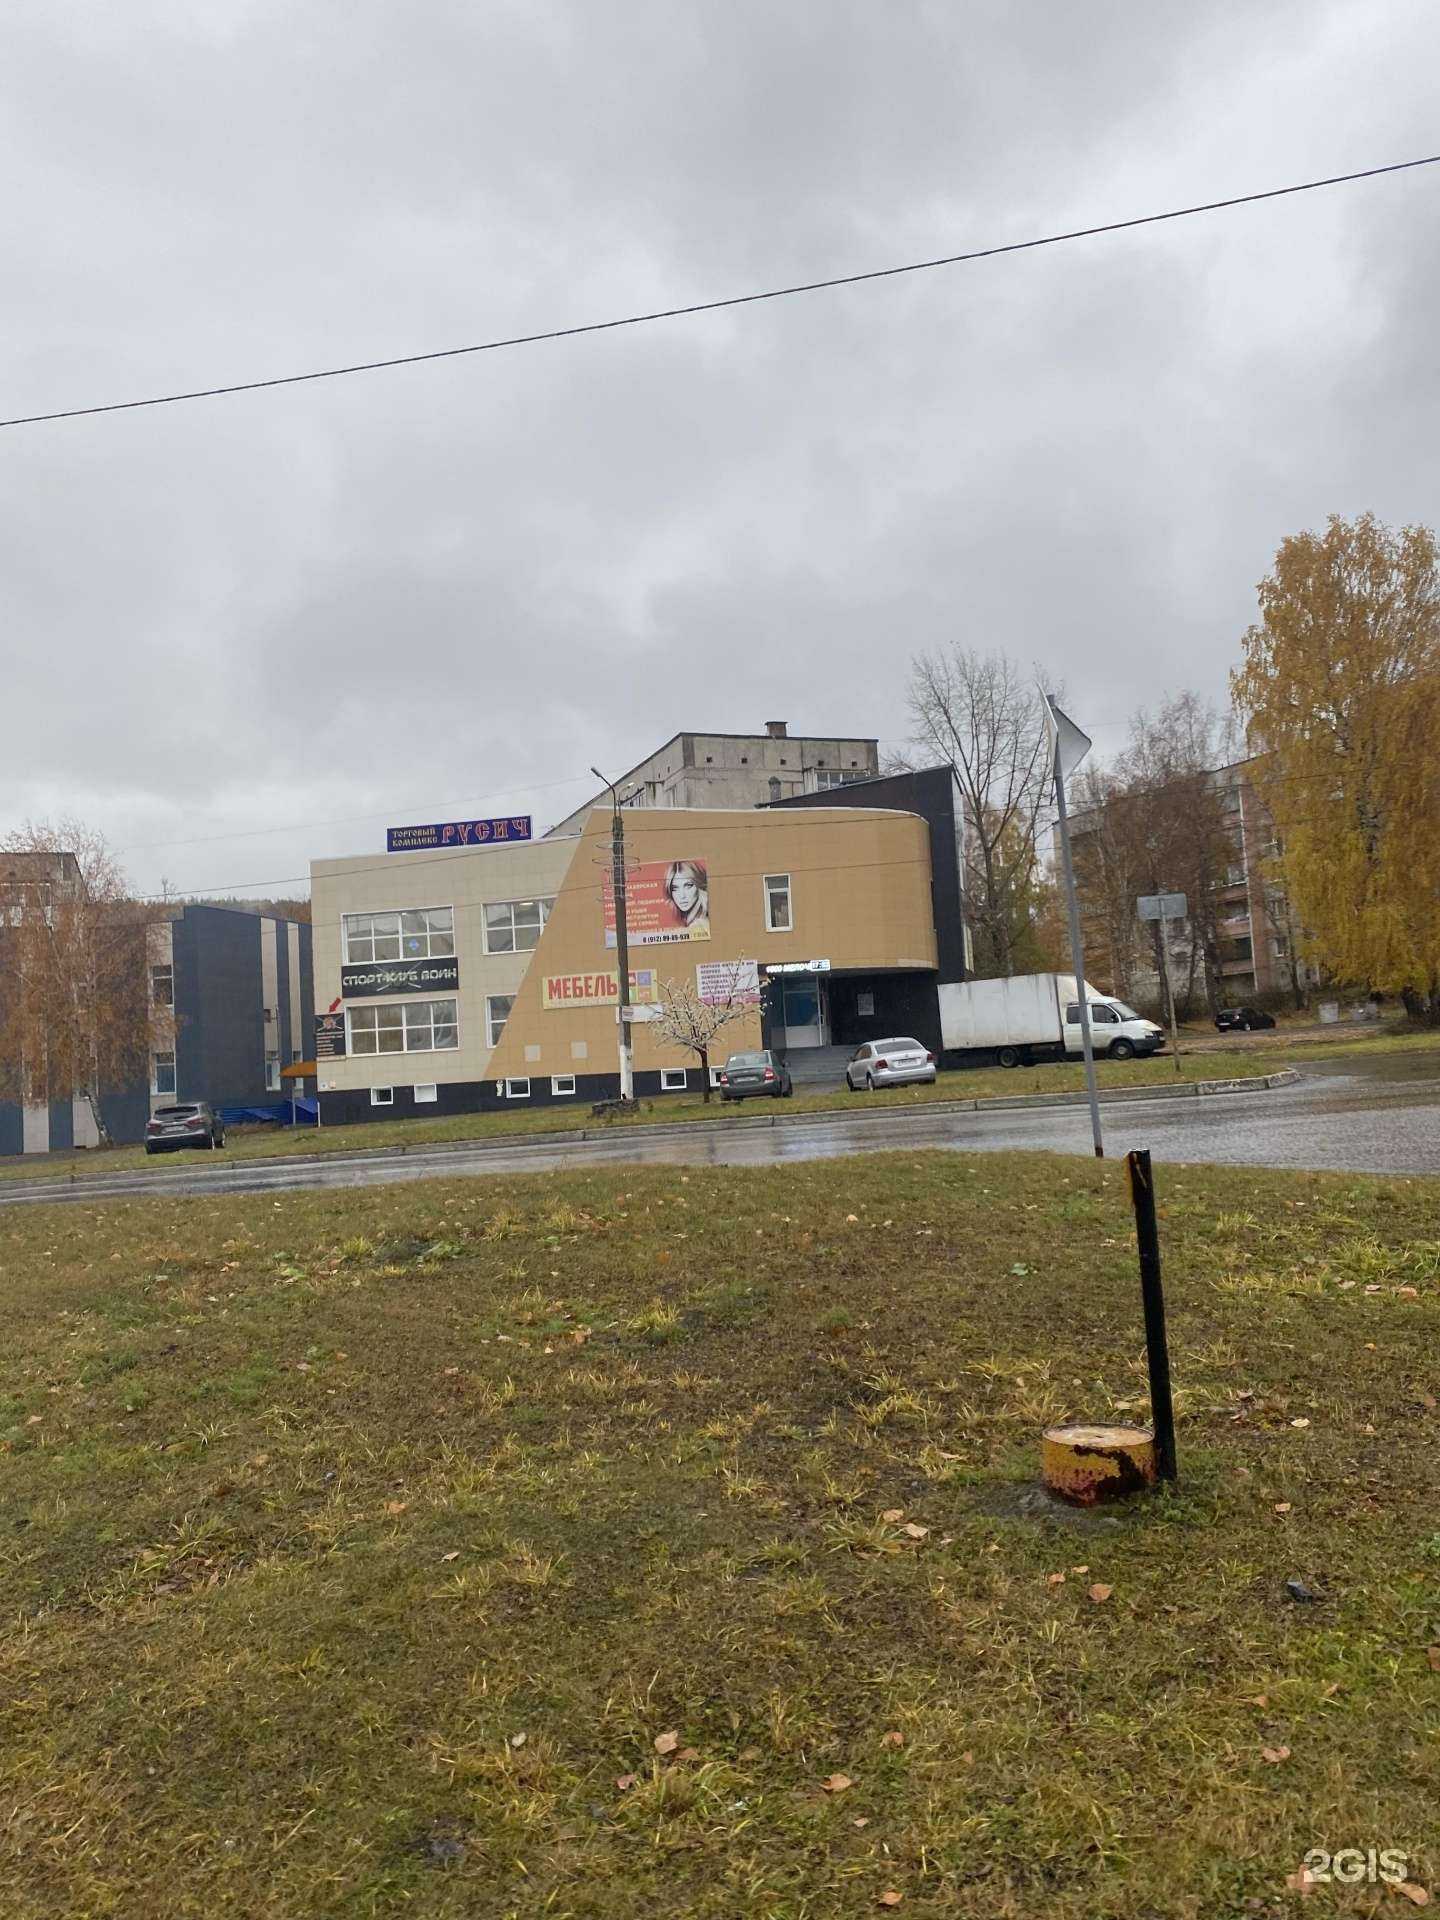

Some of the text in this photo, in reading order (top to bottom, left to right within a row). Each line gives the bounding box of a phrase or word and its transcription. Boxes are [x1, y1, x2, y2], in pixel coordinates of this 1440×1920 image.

[391, 827, 436, 838] ТОРГОВЫЙ
[442, 819, 528, 845] РУСИЧ
[392, 837, 438, 847] КОМПЛЕКС
[421, 968, 456, 981] ВОИН
[547, 975, 618, 1000] МЕБЕЛЬ
